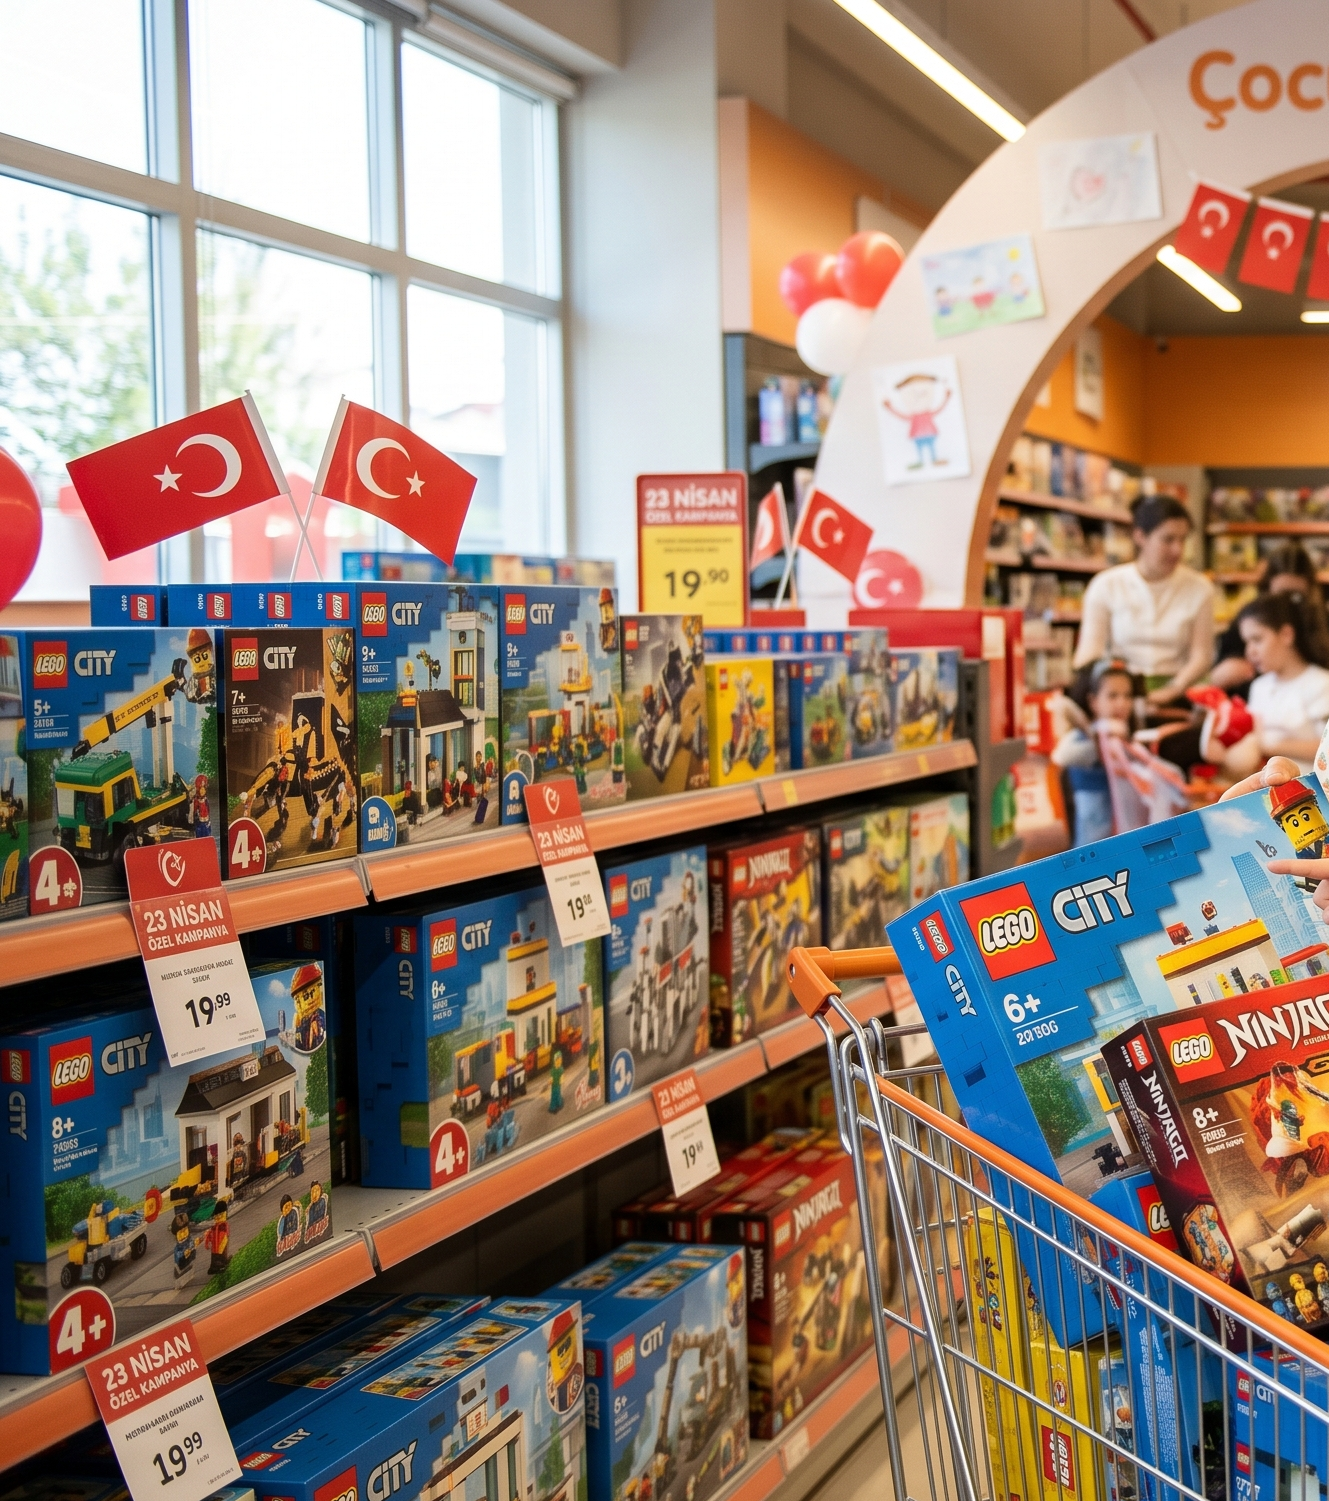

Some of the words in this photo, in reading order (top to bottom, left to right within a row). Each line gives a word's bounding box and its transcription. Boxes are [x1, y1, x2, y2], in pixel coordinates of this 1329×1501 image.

[645, 488, 670, 509] 23
[674, 483, 737, 509] NİSAN
[392, 602, 423, 626] CITY
[529, 603, 555, 624] CITY
[74, 650, 116, 677] CITY
[263, 647, 297, 670] CITY
[34, 700, 51, 716] 5+
[231, 690, 246, 704] 7+
[553, 824, 584, 845] NİSAN
[143, 910, 167, 933] 23
[171, 900, 224, 930] NİSAN
[1052, 868, 1131, 935] CITY
[148, 934, 175, 951] ÖZEL
[461, 919, 493, 951] CITY
[980, 907, 1038, 955] LEGO
[944, 963, 979, 1018] CITY
[1003, 993, 1042, 1024] 6+
[53, 1055, 92, 1087] LEGO
[101, 1032, 153, 1077] CITY
[1170, 1033, 1212, 1065] LEGO
[8, 1090, 28, 1141] CITY
[51, 1117, 75, 1138] 8+
[1141, 1069, 1190, 1170] NINJAGO
[1192, 1107, 1219, 1129] 8+
[434, 1131, 466, 1176] 4+
[1149, 1203, 1171, 1234] LE
[56, 1305, 107, 1355] 4+
[639, 1320, 666, 1359] CITY
[101, 1362, 129, 1392] 23
[129, 1332, 192, 1378] NİSAN
[109, 1388, 140, 1410] ÖZEL
[140, 1358, 200, 1396] KAMPANYA
[1256, 1384, 1279, 1405] CIT
[366, 1438, 419, 1501] CITY
